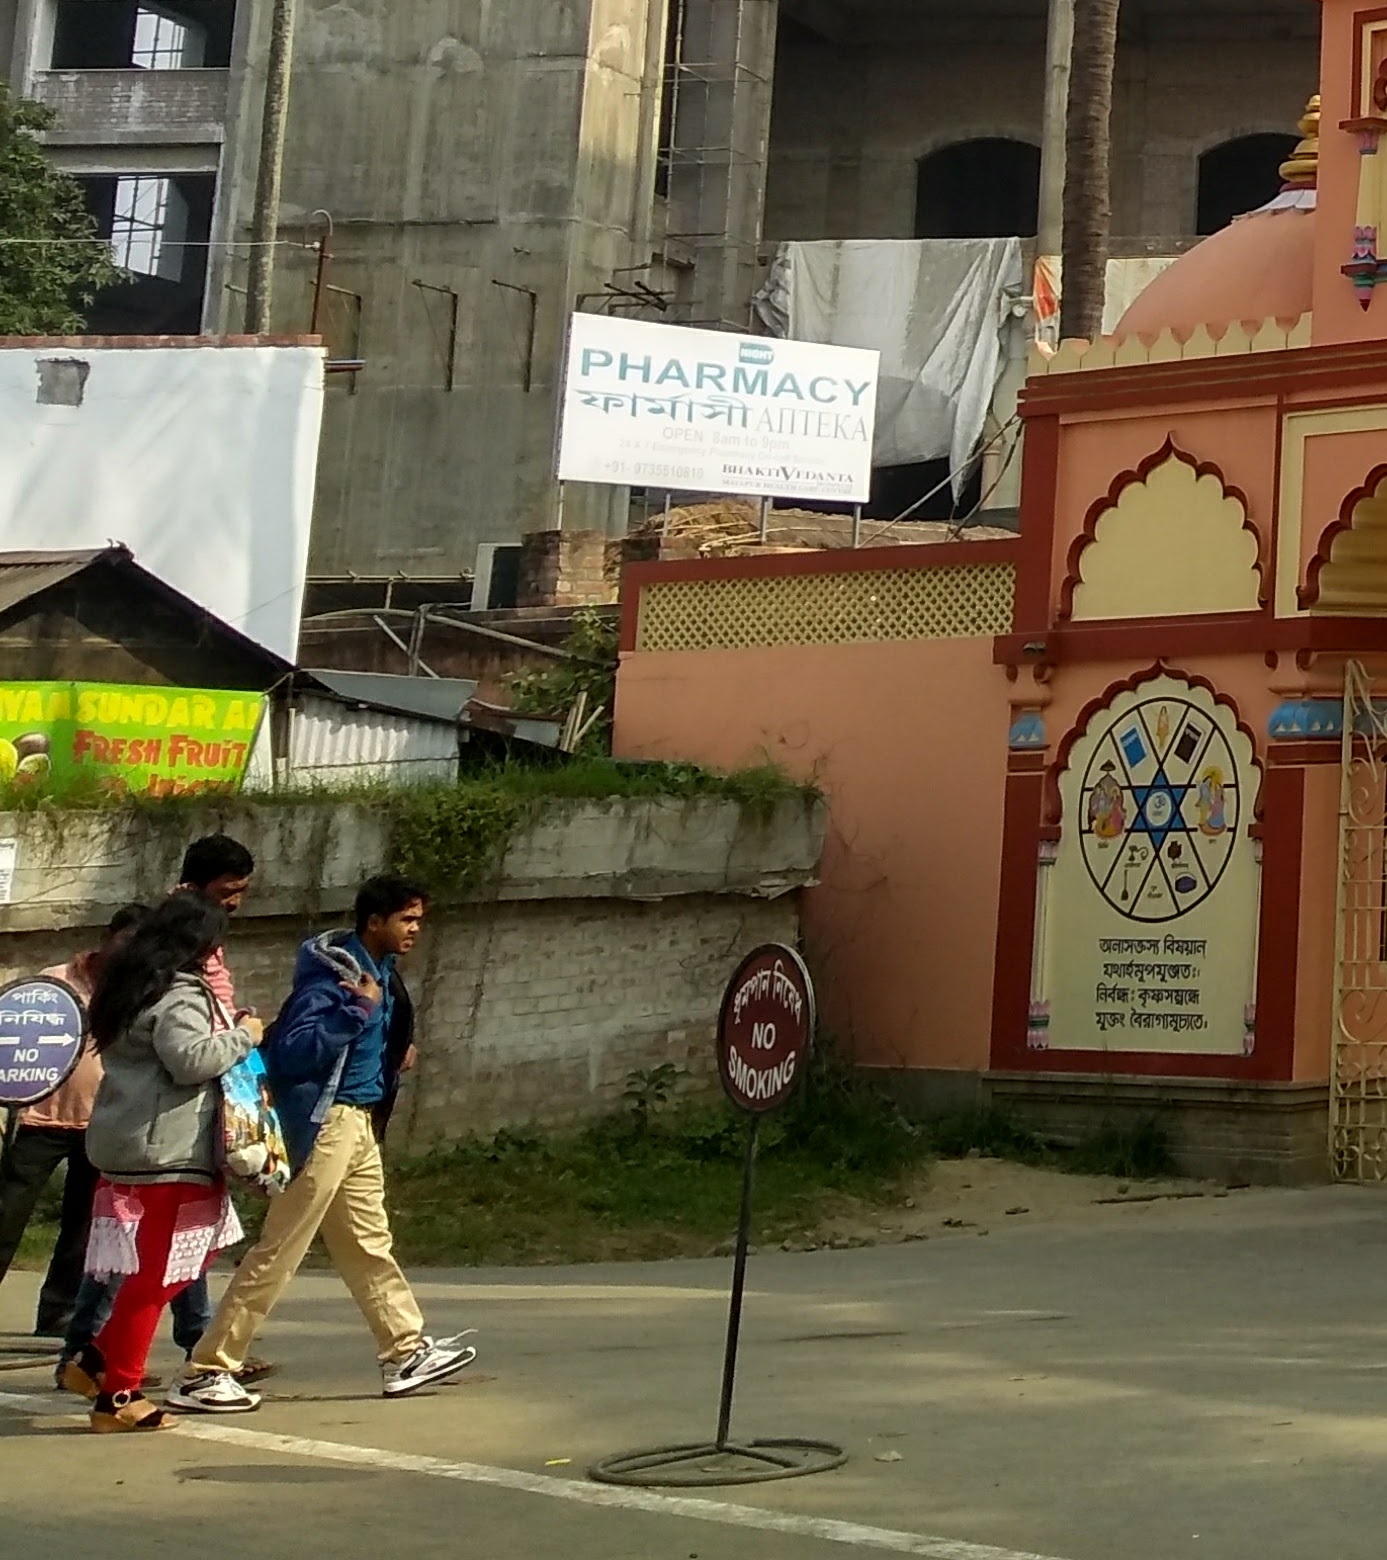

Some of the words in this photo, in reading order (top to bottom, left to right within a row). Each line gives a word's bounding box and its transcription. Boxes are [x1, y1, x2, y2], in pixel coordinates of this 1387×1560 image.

[581, 348, 871, 406] PHARMACY
[662, 426, 703, 443] OPEN
[712, 429, 741, 446] 8am
[744, 436, 758, 448] to
[761, 436, 789, 452] 9pm
[77, 691, 215, 731] SUNDAR
[73, 729, 162, 766] FRESH
[11, 988, 58, 1005] পার্কিং
[751, 1022, 776, 1049] NO
[14, 1048, 39, 1063] NO
[728, 1045, 796, 1100] SMOKING
